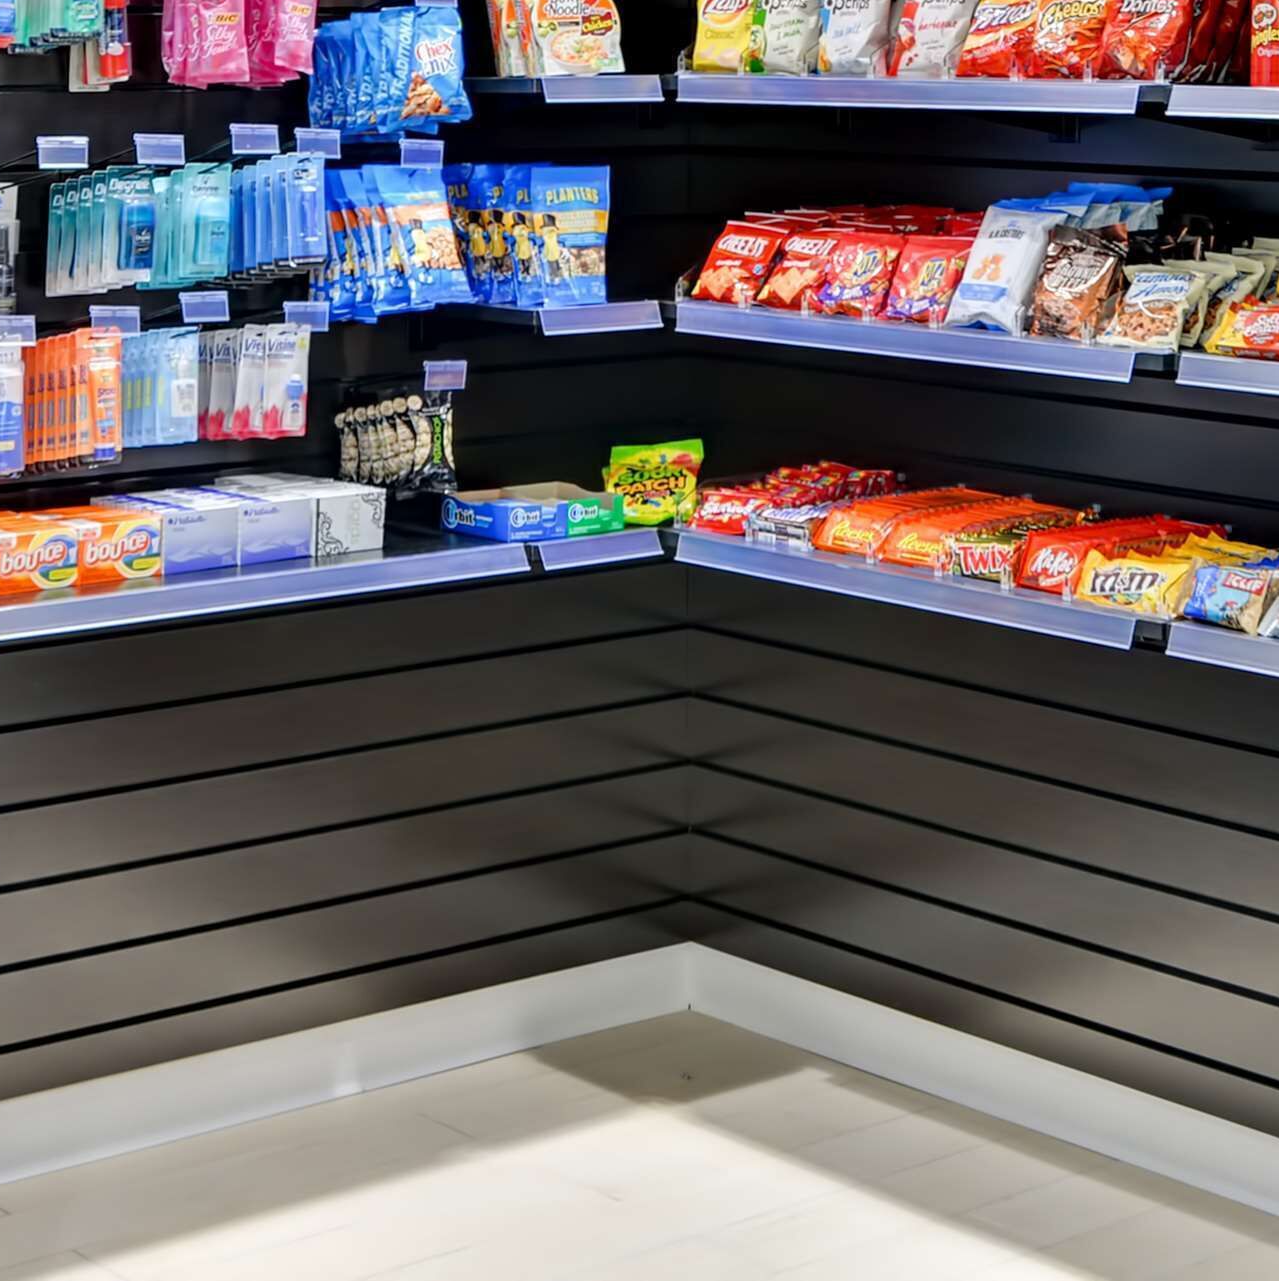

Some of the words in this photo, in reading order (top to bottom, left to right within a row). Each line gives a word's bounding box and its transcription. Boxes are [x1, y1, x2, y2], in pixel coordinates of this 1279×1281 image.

[215, 14, 238, 22] BIC
[544, 2, 590, 17] Noodle
[206, 25, 237, 41] Silky
[389, 10, 416, 99] TRADITIONAL
[415, 37, 454, 60] Chex
[545, 187, 600, 206] PLANTERS
[244, 337, 265, 352] Vis
[618, 465, 685, 485] SOUR
[616, 476, 686, 495] PATCH
[83, 529, 149, 565] bounce
[0, 541, 68, 577] bounce
[959, 544, 1013, 575] TWIX
